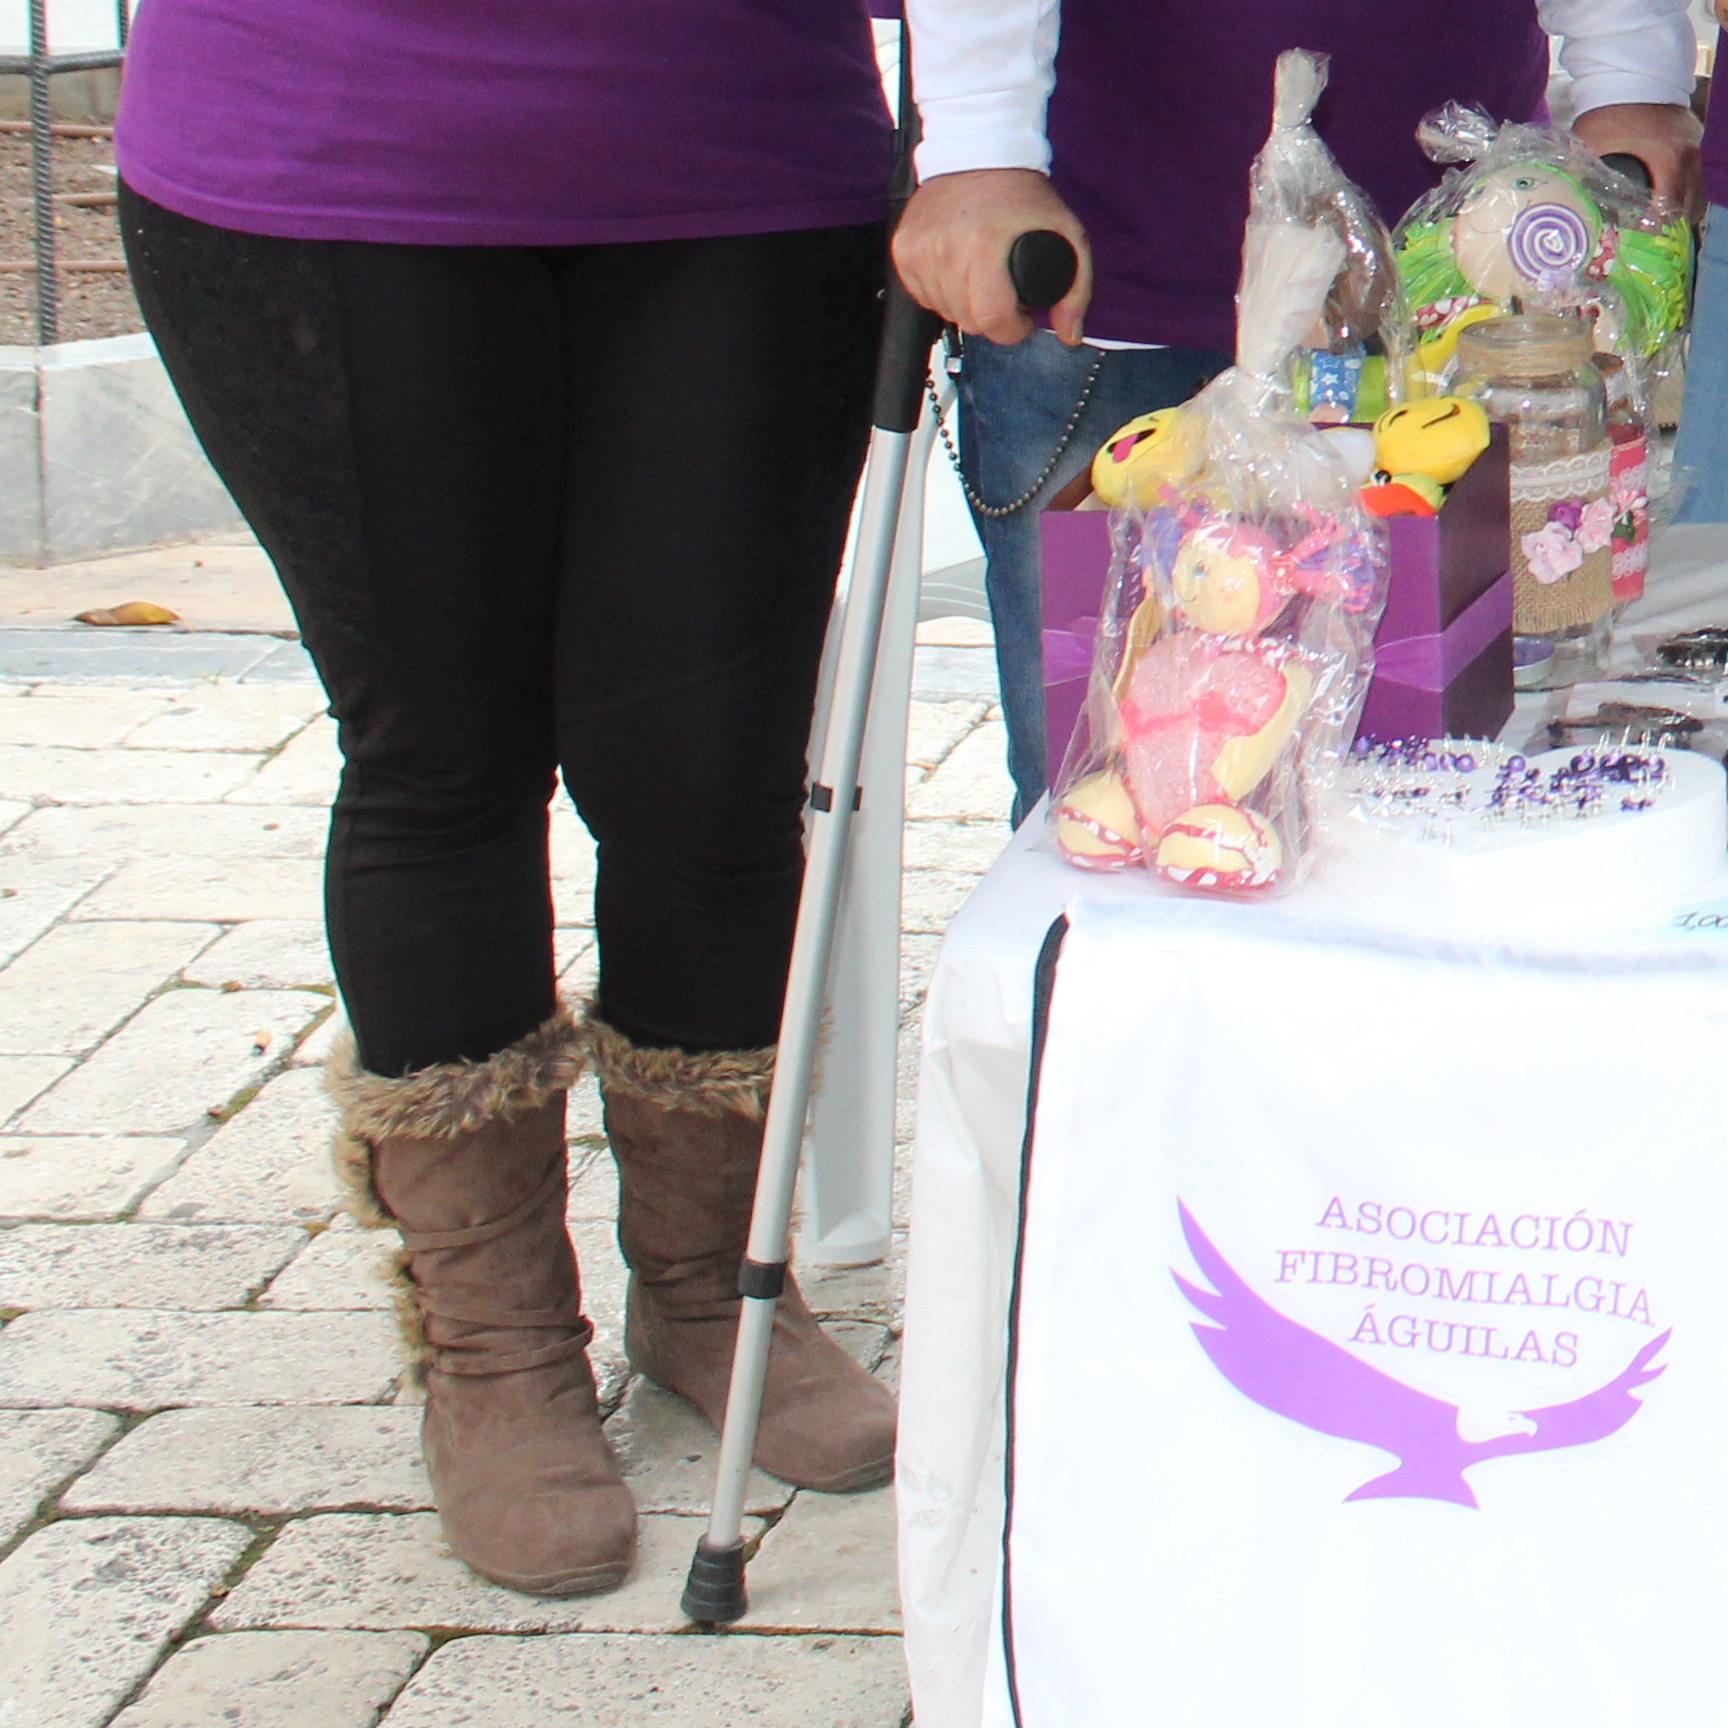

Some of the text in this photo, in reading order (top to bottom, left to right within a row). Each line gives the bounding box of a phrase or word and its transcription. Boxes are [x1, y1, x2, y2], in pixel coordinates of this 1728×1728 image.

[1313, 1194, 1635, 1258] ASOCIACIÓN
[1273, 1249, 1658, 1328] FIBROMIALGIA
[1347, 1303, 1580, 1369] ÁGUILAS
